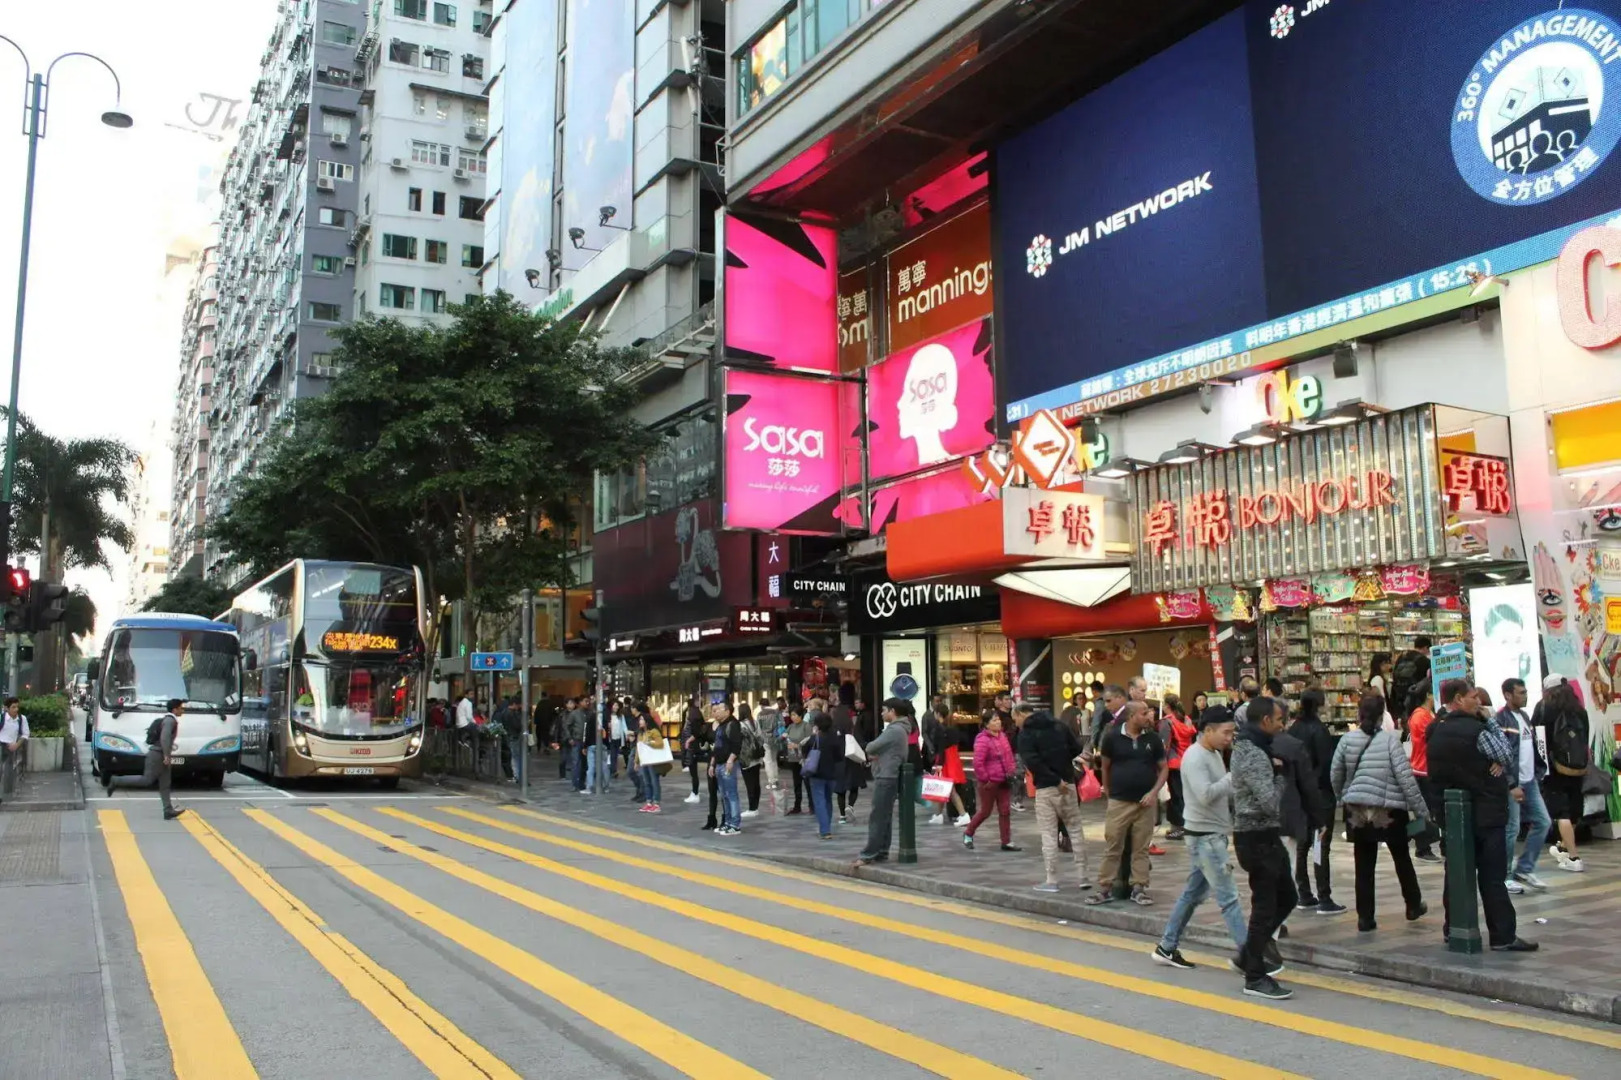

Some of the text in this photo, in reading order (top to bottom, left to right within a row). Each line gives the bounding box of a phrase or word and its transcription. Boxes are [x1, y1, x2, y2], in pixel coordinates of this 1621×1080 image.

[1482, 15, 1621, 73] MANAGEMENT
[1492, 145, 1599, 201] 全方位管理
[1059, 170, 1213, 255] JM NETWORK
[898, 260, 926, 296] 萬寧
[1061, 385, 1144, 421] NETWORK
[767, 458, 800, 477] 莎莎
[1239, 469, 1399, 529] BONJOUR
[793, 580, 846, 592] CITY CHAIN
[900, 583, 981, 607] CITY CHAIN
